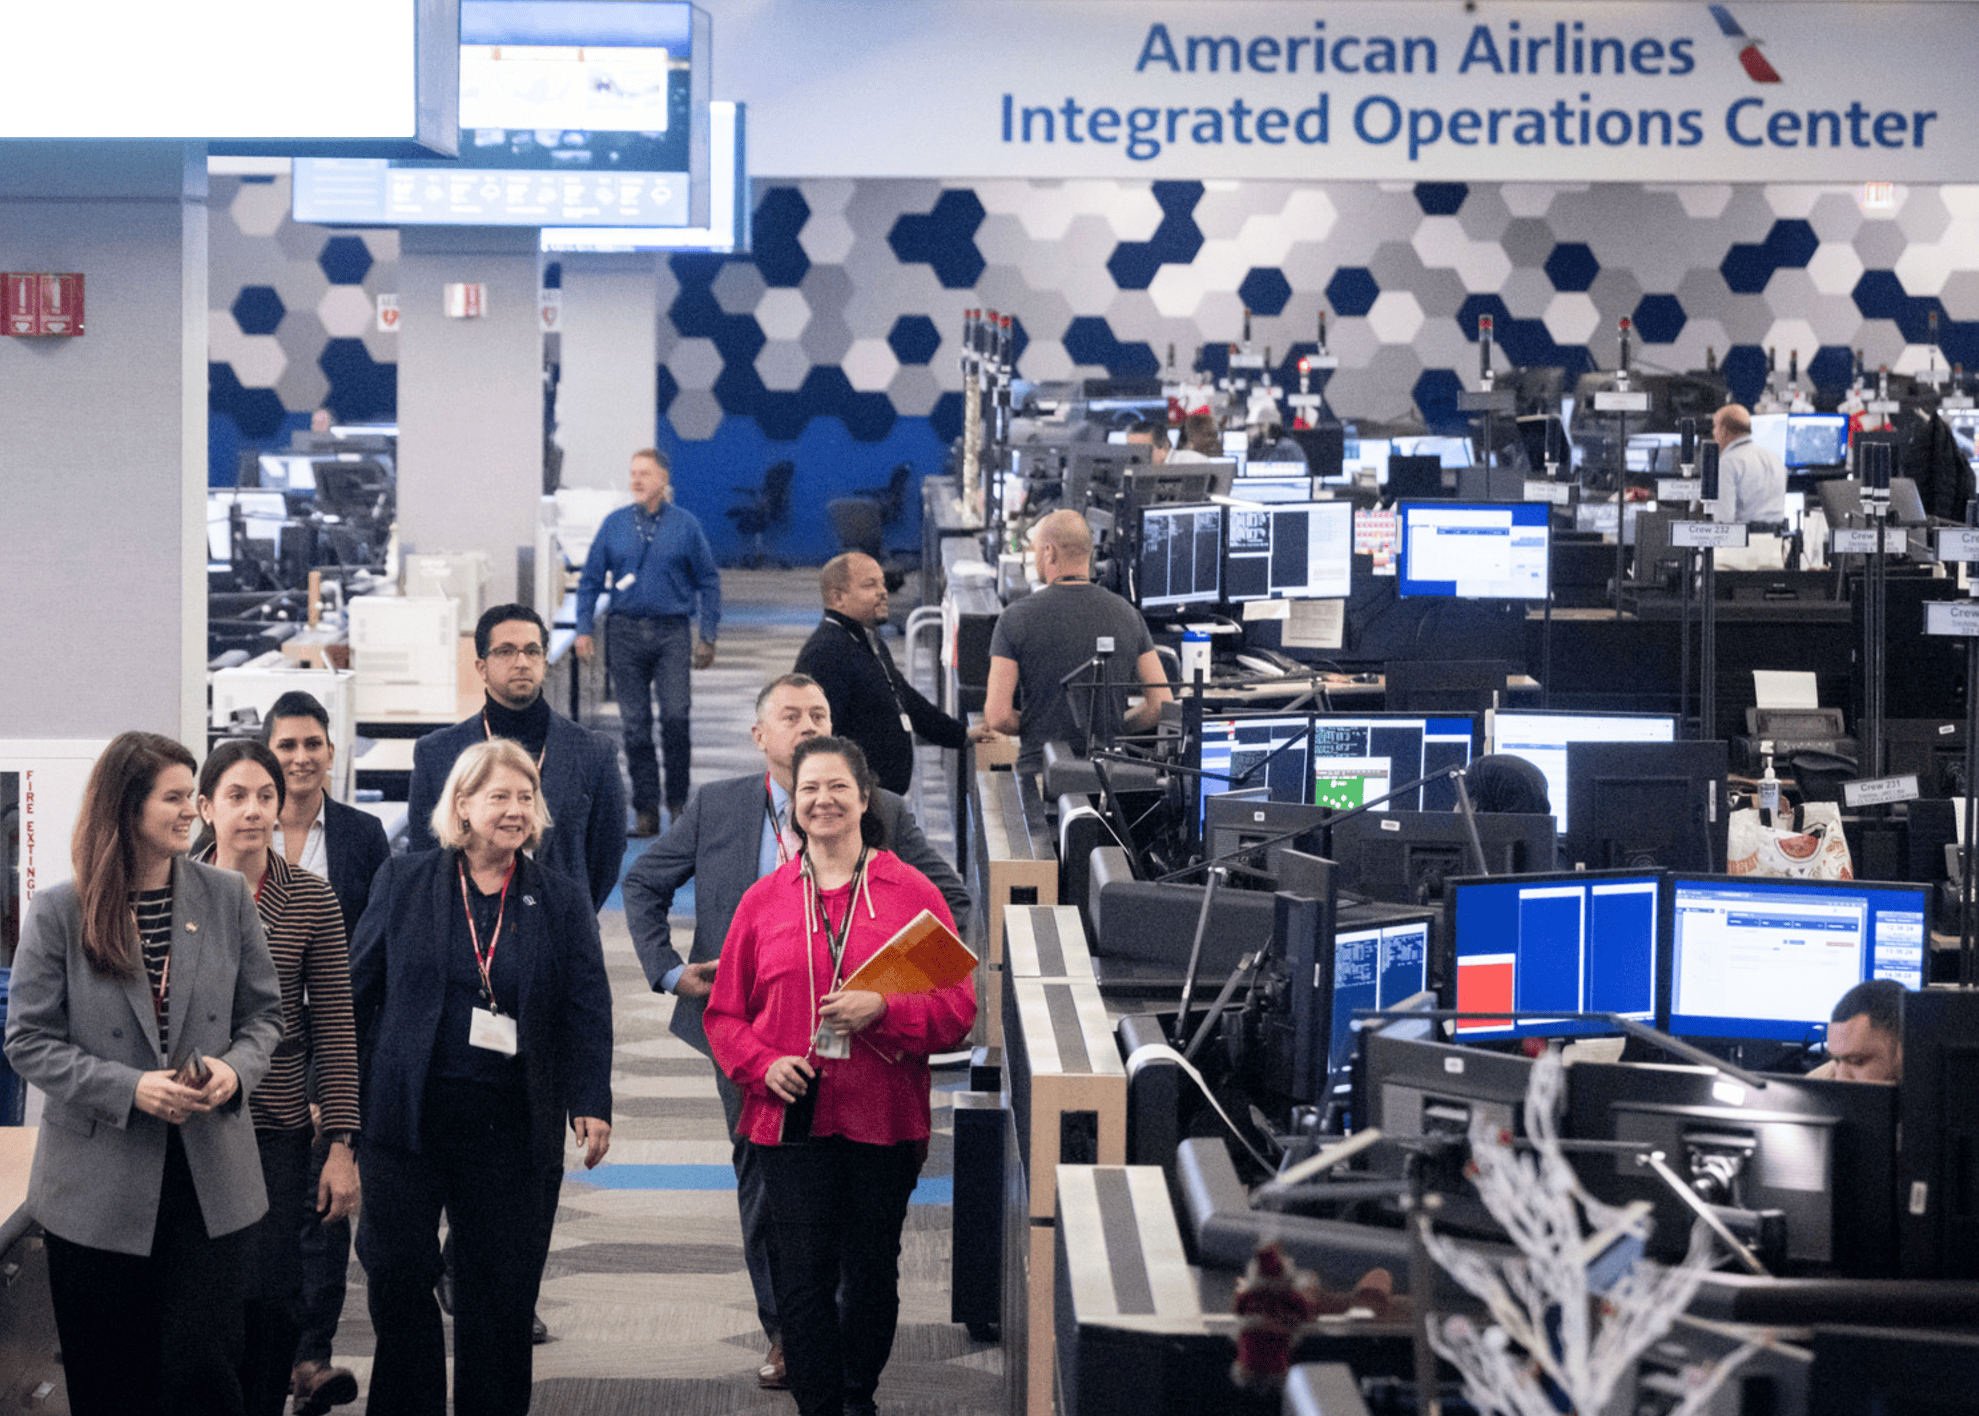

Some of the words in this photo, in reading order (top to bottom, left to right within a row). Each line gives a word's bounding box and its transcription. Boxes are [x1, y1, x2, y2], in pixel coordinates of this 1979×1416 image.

[1136, 20, 1438, 74] American
[1458, 20, 1696, 76] Airlines
[1002, 92, 1330, 161] Integrated
[1353, 92, 1704, 161] Operations
[1725, 97, 1939, 148] Center
[1689, 525, 1712, 534] Crew
[1850, 531, 1875, 540] Crew
[26, 770, 34, 814] FIRE
[1860, 783, 1884, 792] Crew
[1886, 779, 1900, 789] 231
